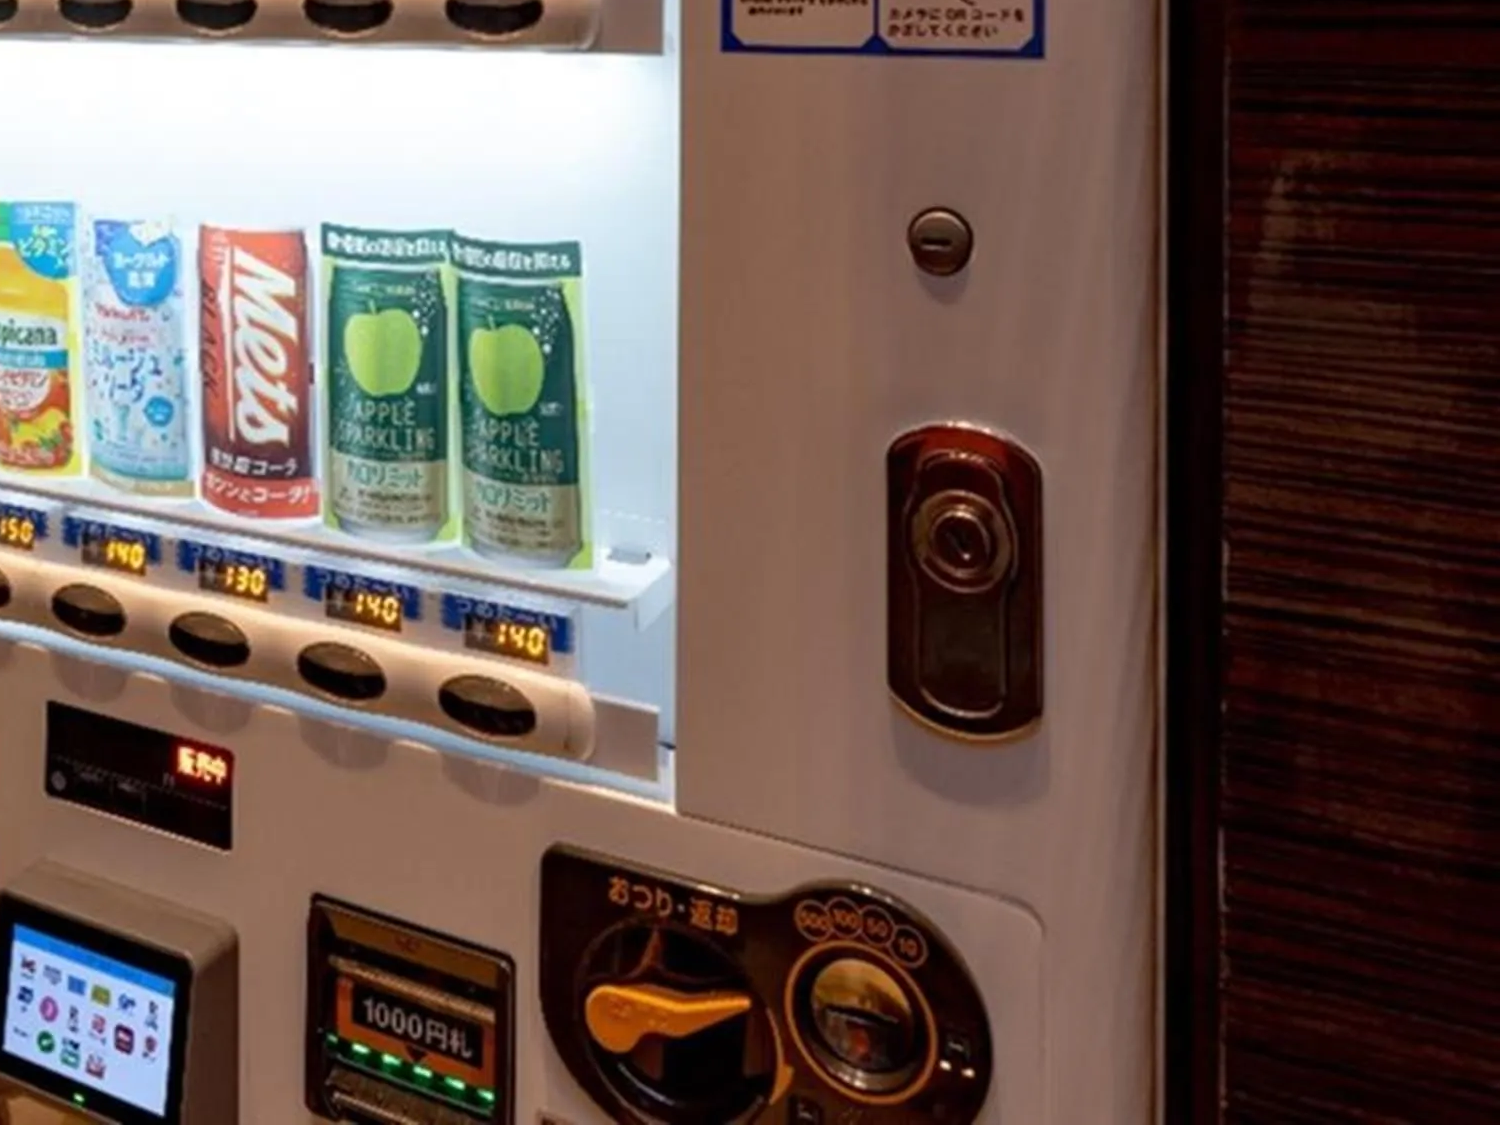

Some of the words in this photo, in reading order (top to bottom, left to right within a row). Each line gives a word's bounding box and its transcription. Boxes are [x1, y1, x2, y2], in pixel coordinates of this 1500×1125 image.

[0, 516, 34, 544] 150
[106, 541, 145, 569] 140
[224, 566, 266, 595] 130
[355, 592, 399, 623] 140
[498, 623, 544, 655] 140
[608, 876, 739, 936] おつり・返却
[363, 997, 473, 1058] 1000円札
